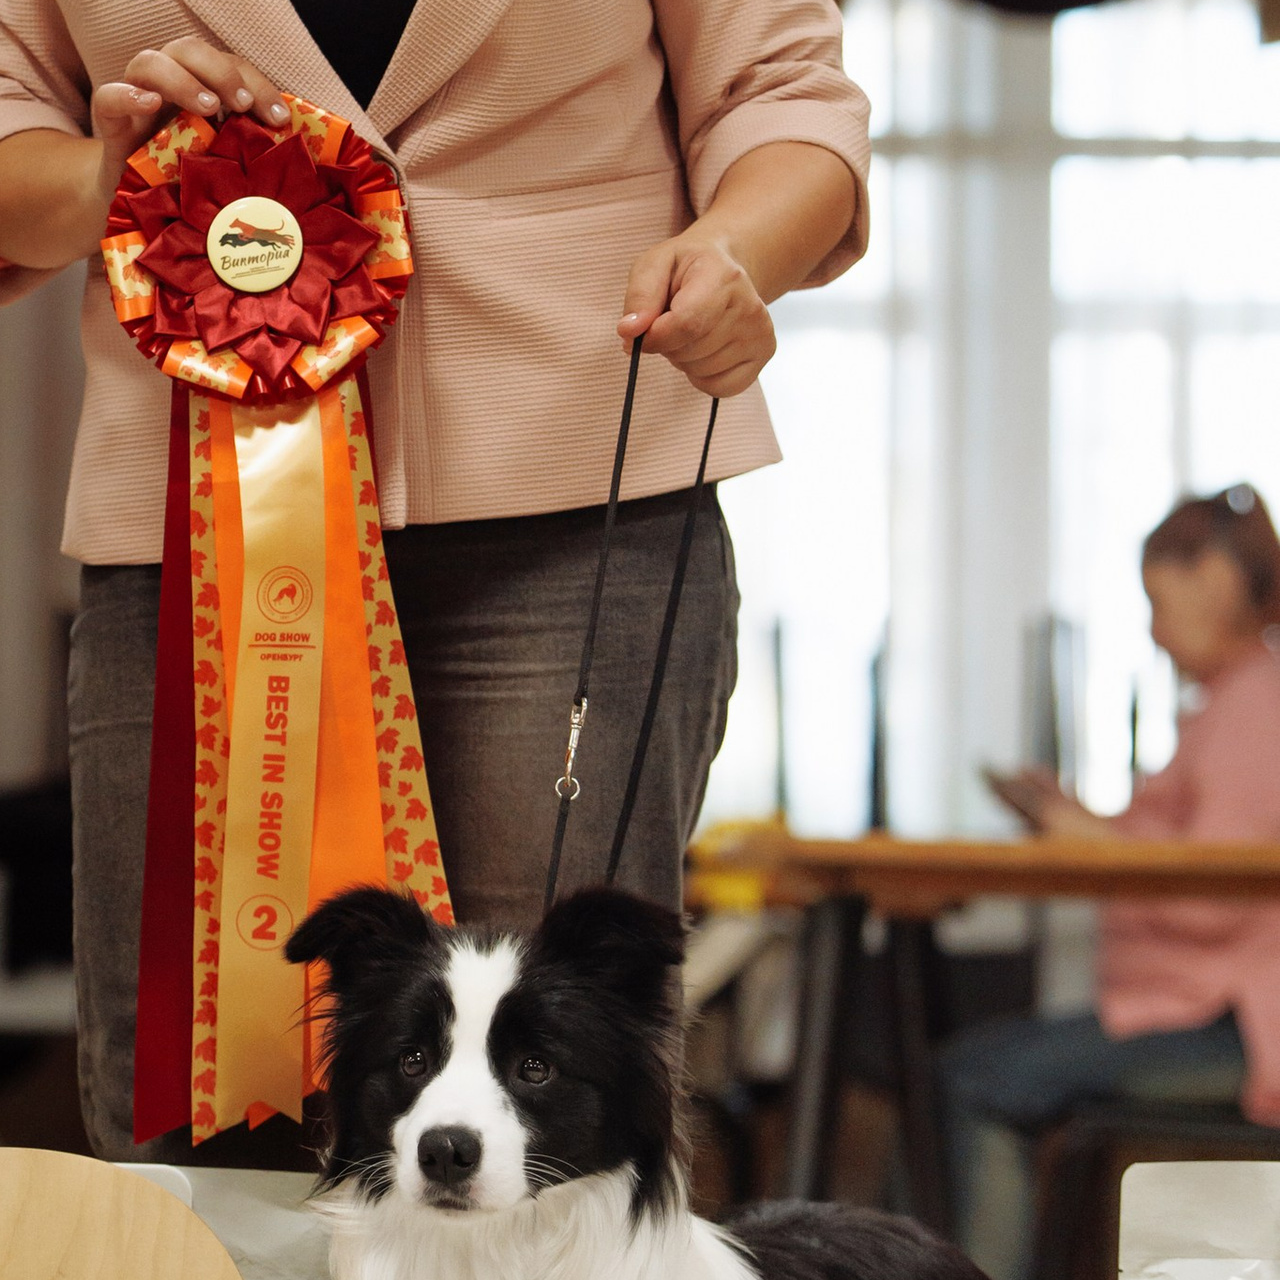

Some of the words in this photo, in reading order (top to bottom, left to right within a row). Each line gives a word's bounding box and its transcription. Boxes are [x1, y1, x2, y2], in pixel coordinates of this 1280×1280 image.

[220, 249, 291, 271] Виктория
[254, 632, 277, 642] DOG
[279, 632, 311, 642] SHOW
[264, 675, 291, 747] BEST
[261, 753, 286, 783] IN
[256, 790, 284, 880] SHOW
[251, 904, 278, 941] 2
